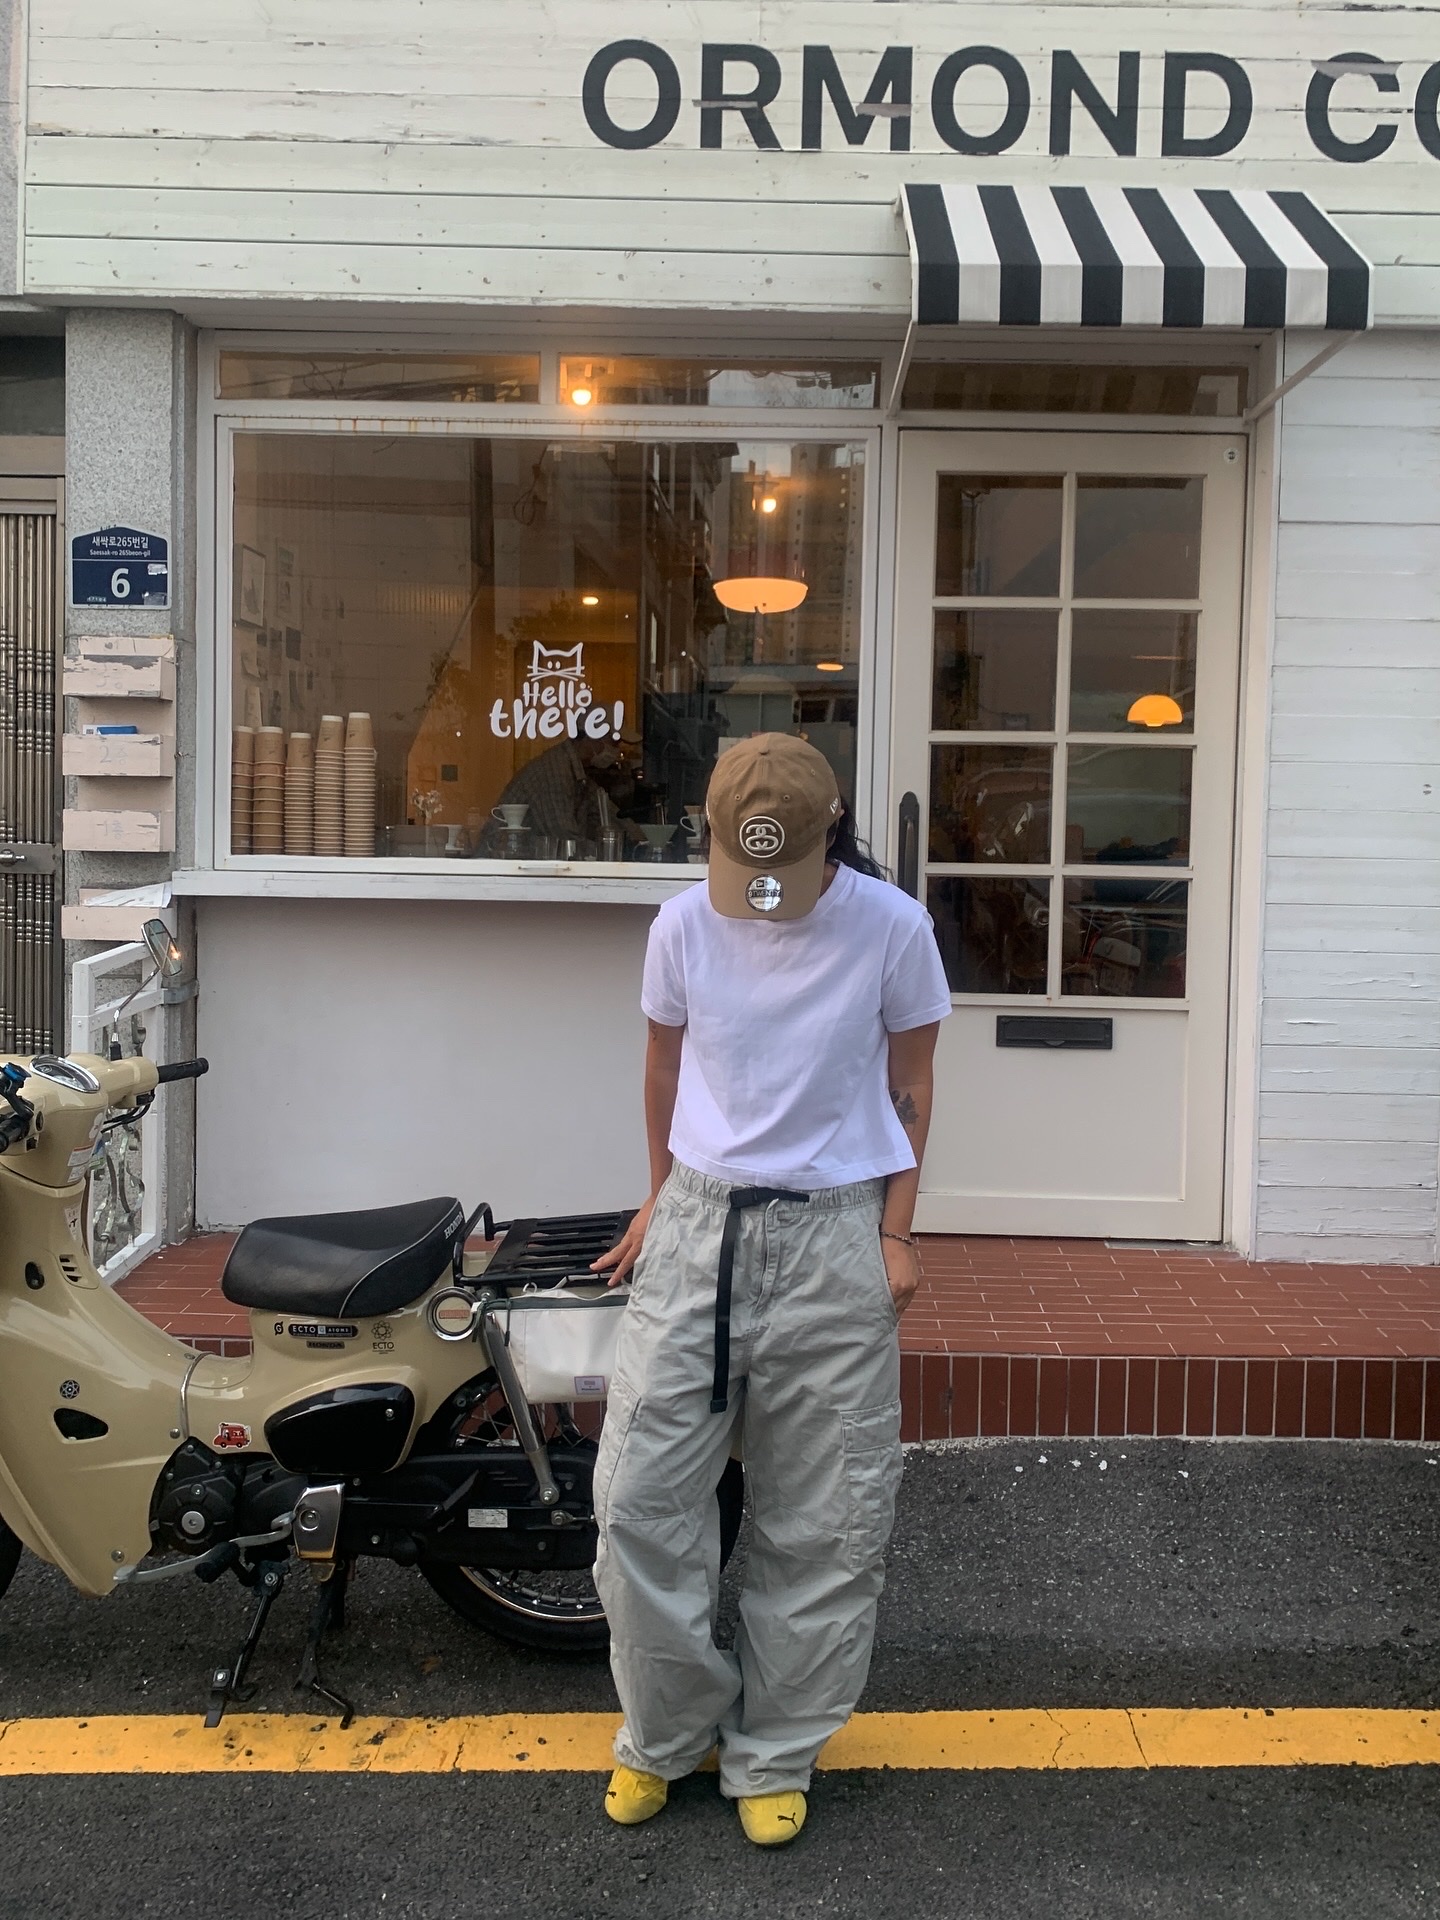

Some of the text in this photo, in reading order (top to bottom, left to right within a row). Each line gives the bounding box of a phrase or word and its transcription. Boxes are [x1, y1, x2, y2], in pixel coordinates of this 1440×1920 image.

[582, 39, 1440, 163] ORMOND C
[92, 535, 149, 549] 새싹로265번길
[111, 567, 131, 599] 6
[523, 680, 593, 709] Hello
[489, 698, 625, 742] there!
[292, 1325, 316, 1334] ECTO
[372, 1341, 395, 1350] ECTO
